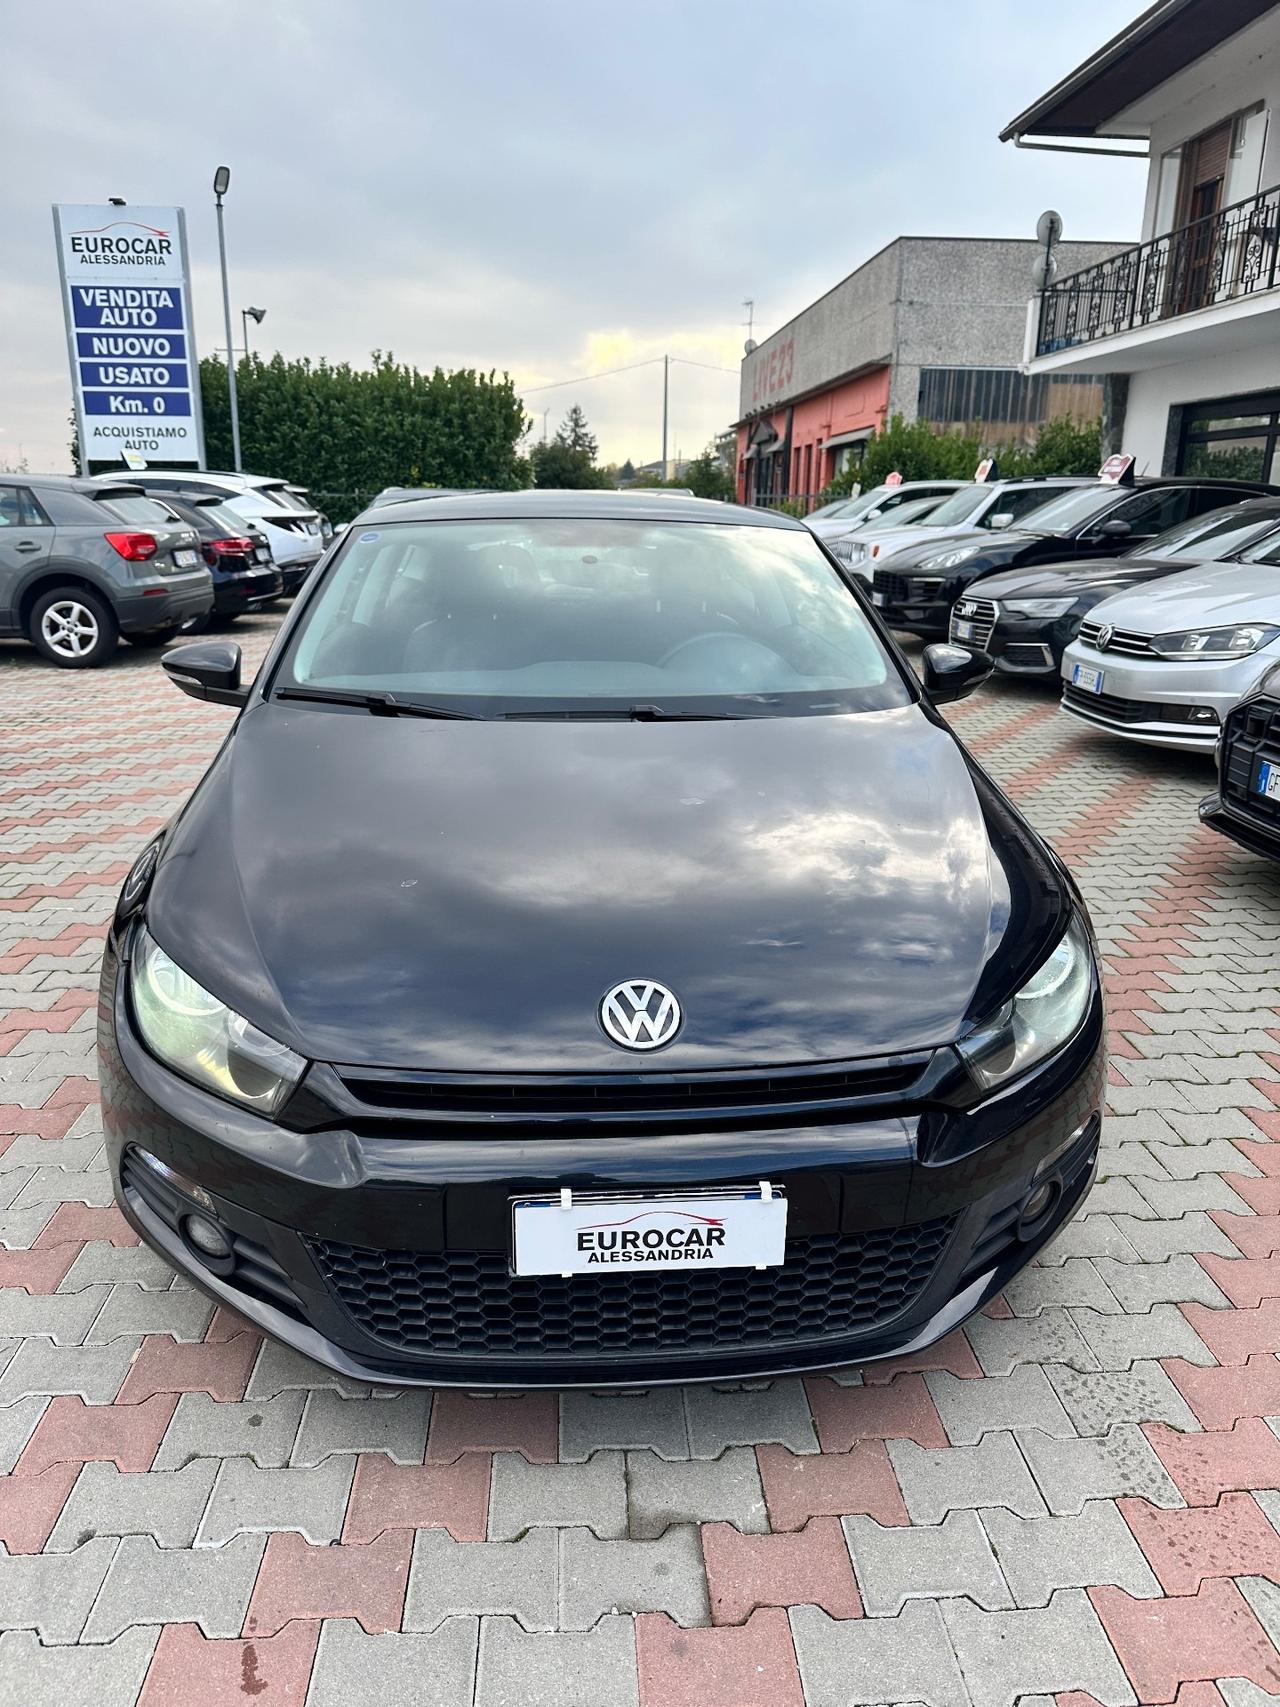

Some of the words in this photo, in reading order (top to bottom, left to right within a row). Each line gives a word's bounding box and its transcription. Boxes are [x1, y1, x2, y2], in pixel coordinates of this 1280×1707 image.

[71, 236, 172, 255] EUROCAR
[80, 254, 166, 266] ALESSANDRIA
[79, 288, 174, 308] VENDITA
[100, 308, 157, 326] AUTO
[92, 337, 170, 356] NUOVO
[99, 366, 170, 385] USATO
[109, 396, 149, 414] Km.
[153, 396, 166, 414] 0
[93, 426, 187, 439] ACQUISTIAMO
[124, 440, 159, 451] AUTO
[577, 1227, 725, 1251] EUROCAR
[587, 1248, 714, 1264] ALESSANDRIA
